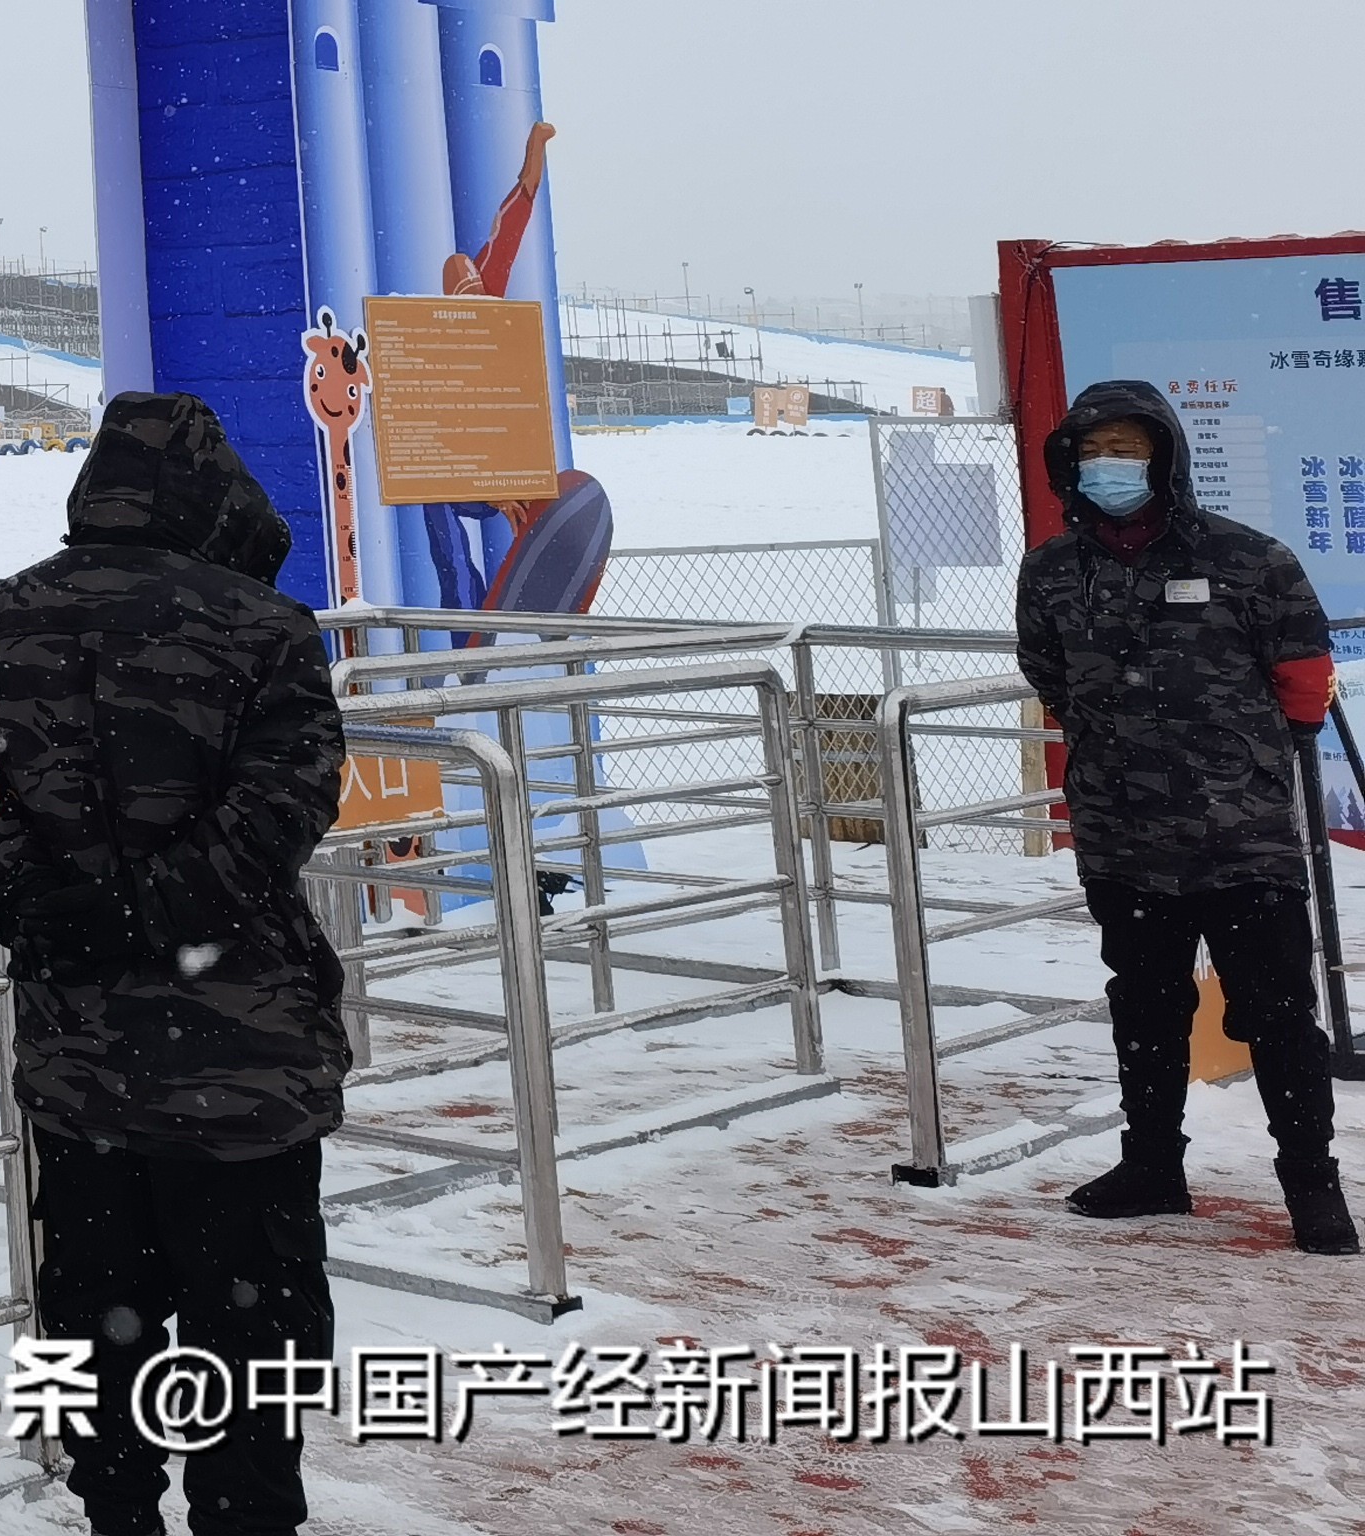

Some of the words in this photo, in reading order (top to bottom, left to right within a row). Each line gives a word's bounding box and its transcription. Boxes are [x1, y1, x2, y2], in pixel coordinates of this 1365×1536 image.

[1314, 278, 1363, 321] 售
[1331, 630, 1365, 639] 工作人
